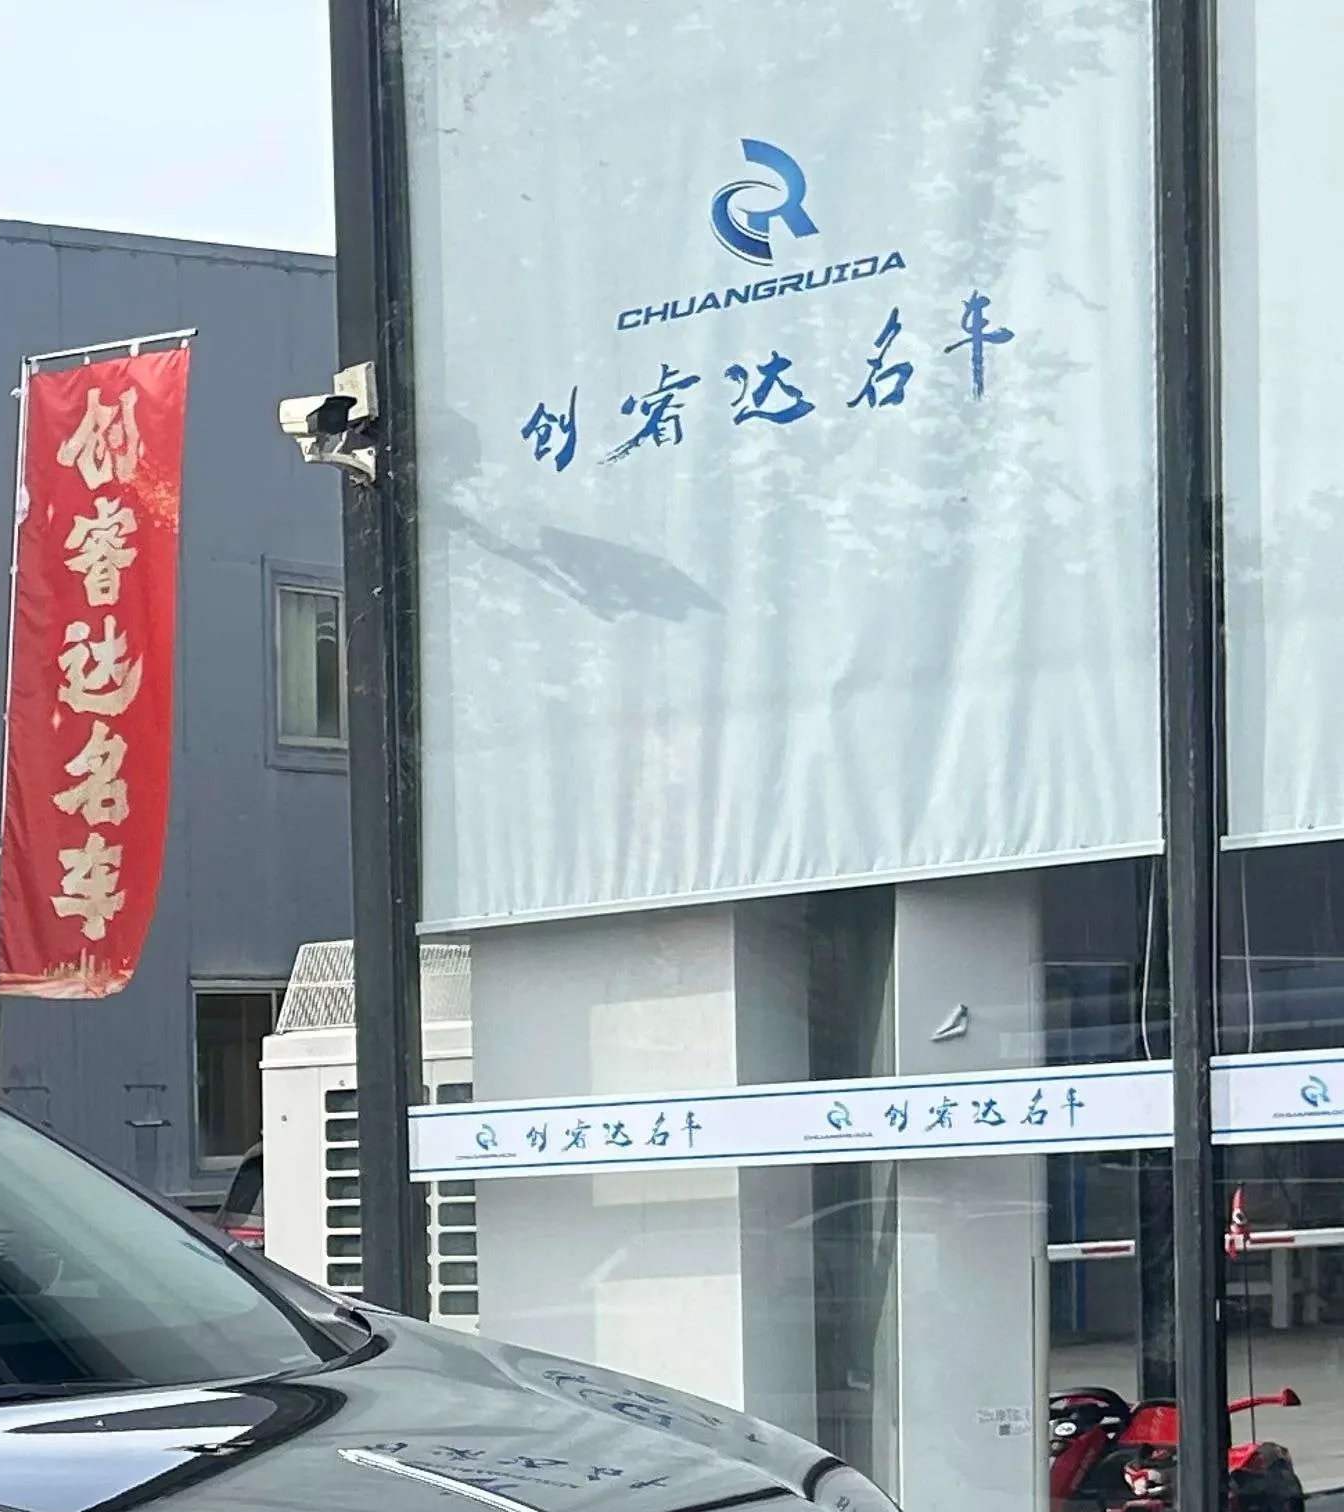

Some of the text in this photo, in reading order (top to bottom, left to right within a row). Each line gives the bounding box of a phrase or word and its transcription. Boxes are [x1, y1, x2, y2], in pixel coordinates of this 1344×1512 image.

[518, 288, 1015, 473] 创睿达名车
[615, 250, 907, 332] CHUANGRUIDA
[50, 387, 144, 940] 创睿达名车
